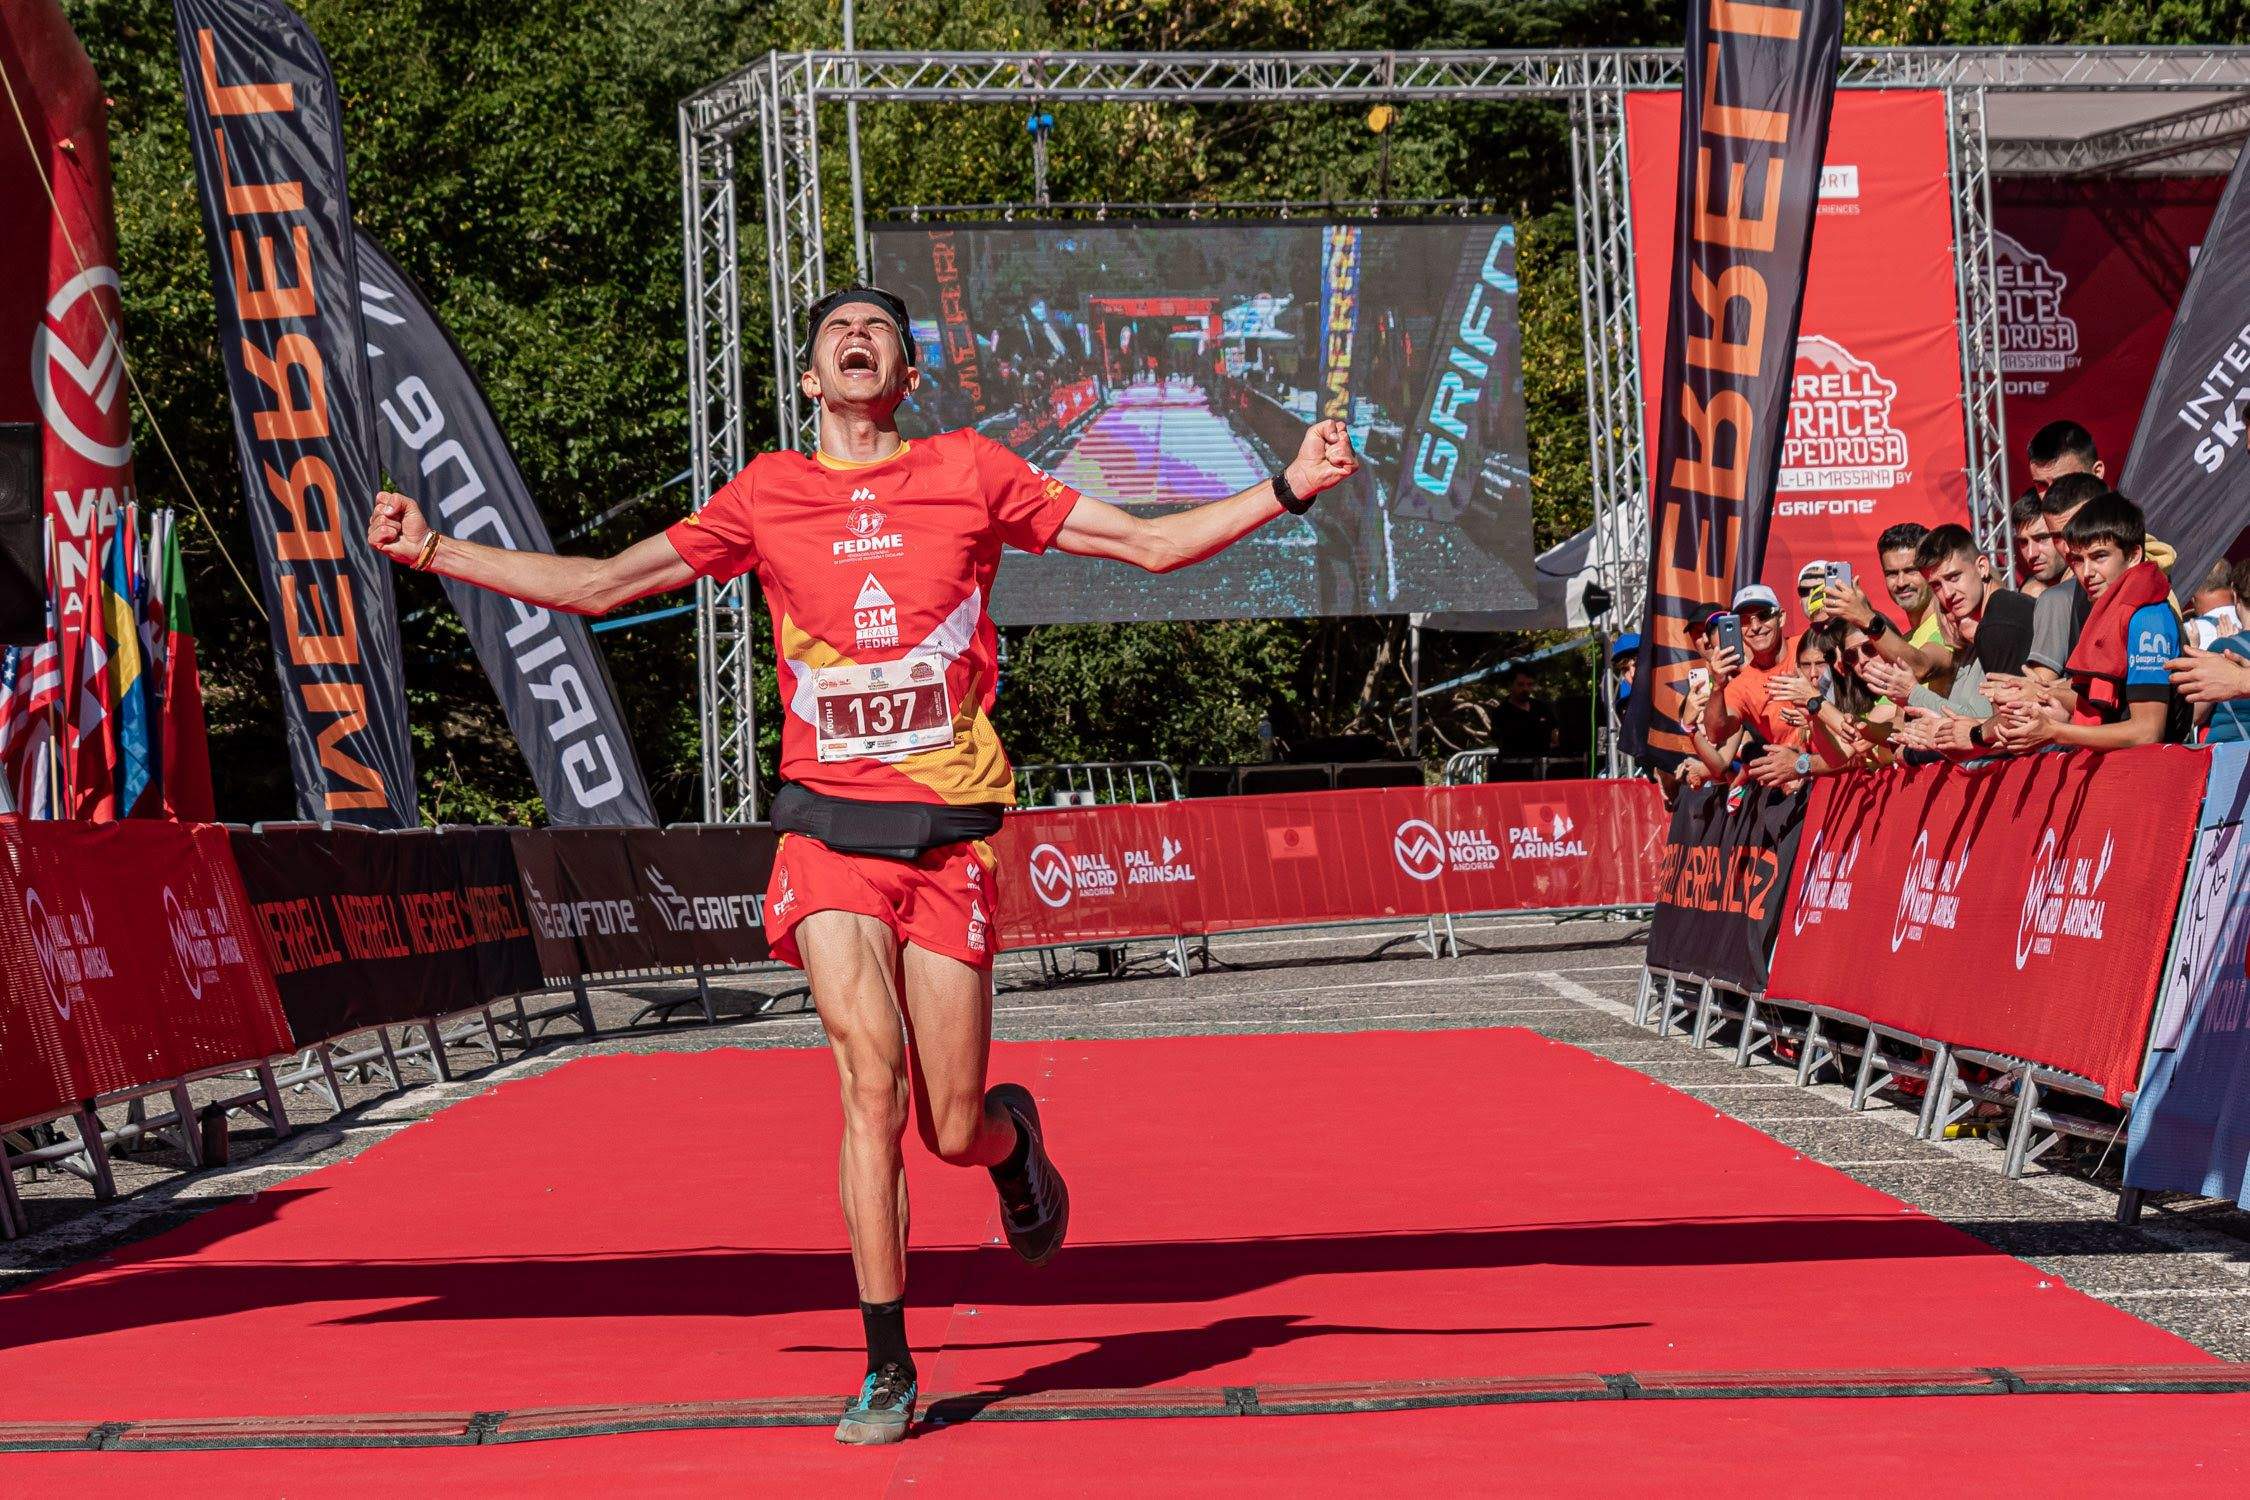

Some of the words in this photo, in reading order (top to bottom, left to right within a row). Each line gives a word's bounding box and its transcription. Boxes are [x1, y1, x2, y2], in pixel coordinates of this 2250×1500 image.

[1790, 374, 1883, 398] RELL
[1785, 399, 1884, 438] RACE
[1819, 469, 1890, 487] MASSANA
[1896, 471, 1912, 485] BY
[53, 486, 129, 537] VA
[832, 533, 903, 556] FEDME
[854, 607, 896, 629] CXM
[856, 636, 899, 650] FEDME
[825, 708, 834, 733] YOUTH
[848, 691, 917, 737] 137
[1445, 829, 1491, 846] VALL
[1509, 827, 1543, 843] PAL
[1124, 850, 1153, 868] PAL
[1449, 845, 1500, 863] NORD
[1513, 841, 1588, 859] ARINSAL
[1071, 853, 1110, 872] VALL
[1453, 861, 1496, 872] ANDORRA
[1075, 869, 1118, 888] NORD
[1128, 864, 1196, 884] ARINSAL
[2070, 858, 2092, 895] PAL
[1079, 886, 1115, 897] ANDORRA
[693, 894, 767, 930] GRIFO
